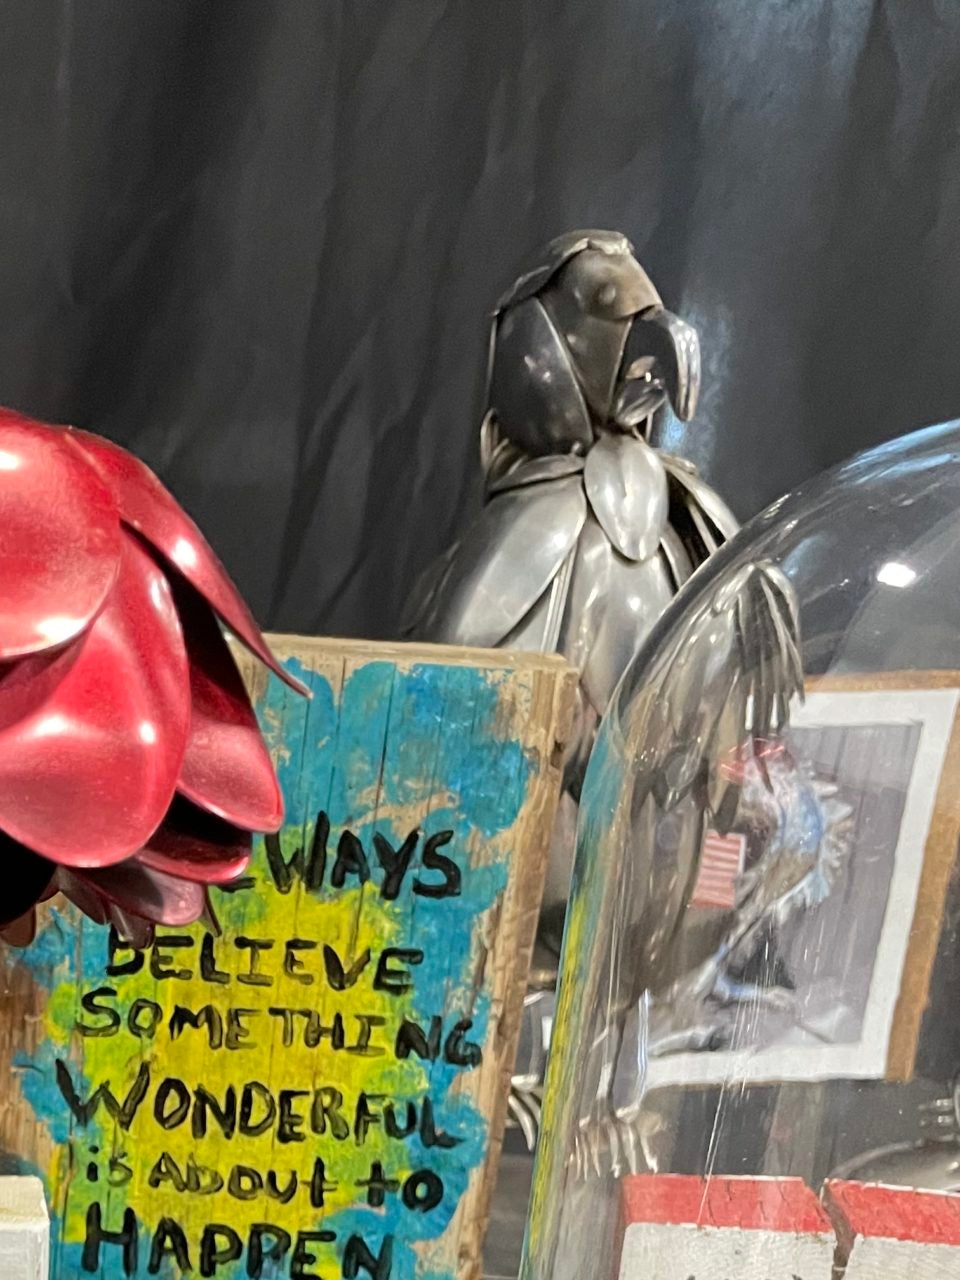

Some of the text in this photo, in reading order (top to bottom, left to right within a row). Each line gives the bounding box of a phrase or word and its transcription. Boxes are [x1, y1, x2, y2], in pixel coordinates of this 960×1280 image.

[217, 810, 461, 901] WAYS
[106, 925, 425, 996] BELIEVE
[75, 987, 483, 1067] SOMETHING
[55, 1057, 464, 1150] WONDERFUL
